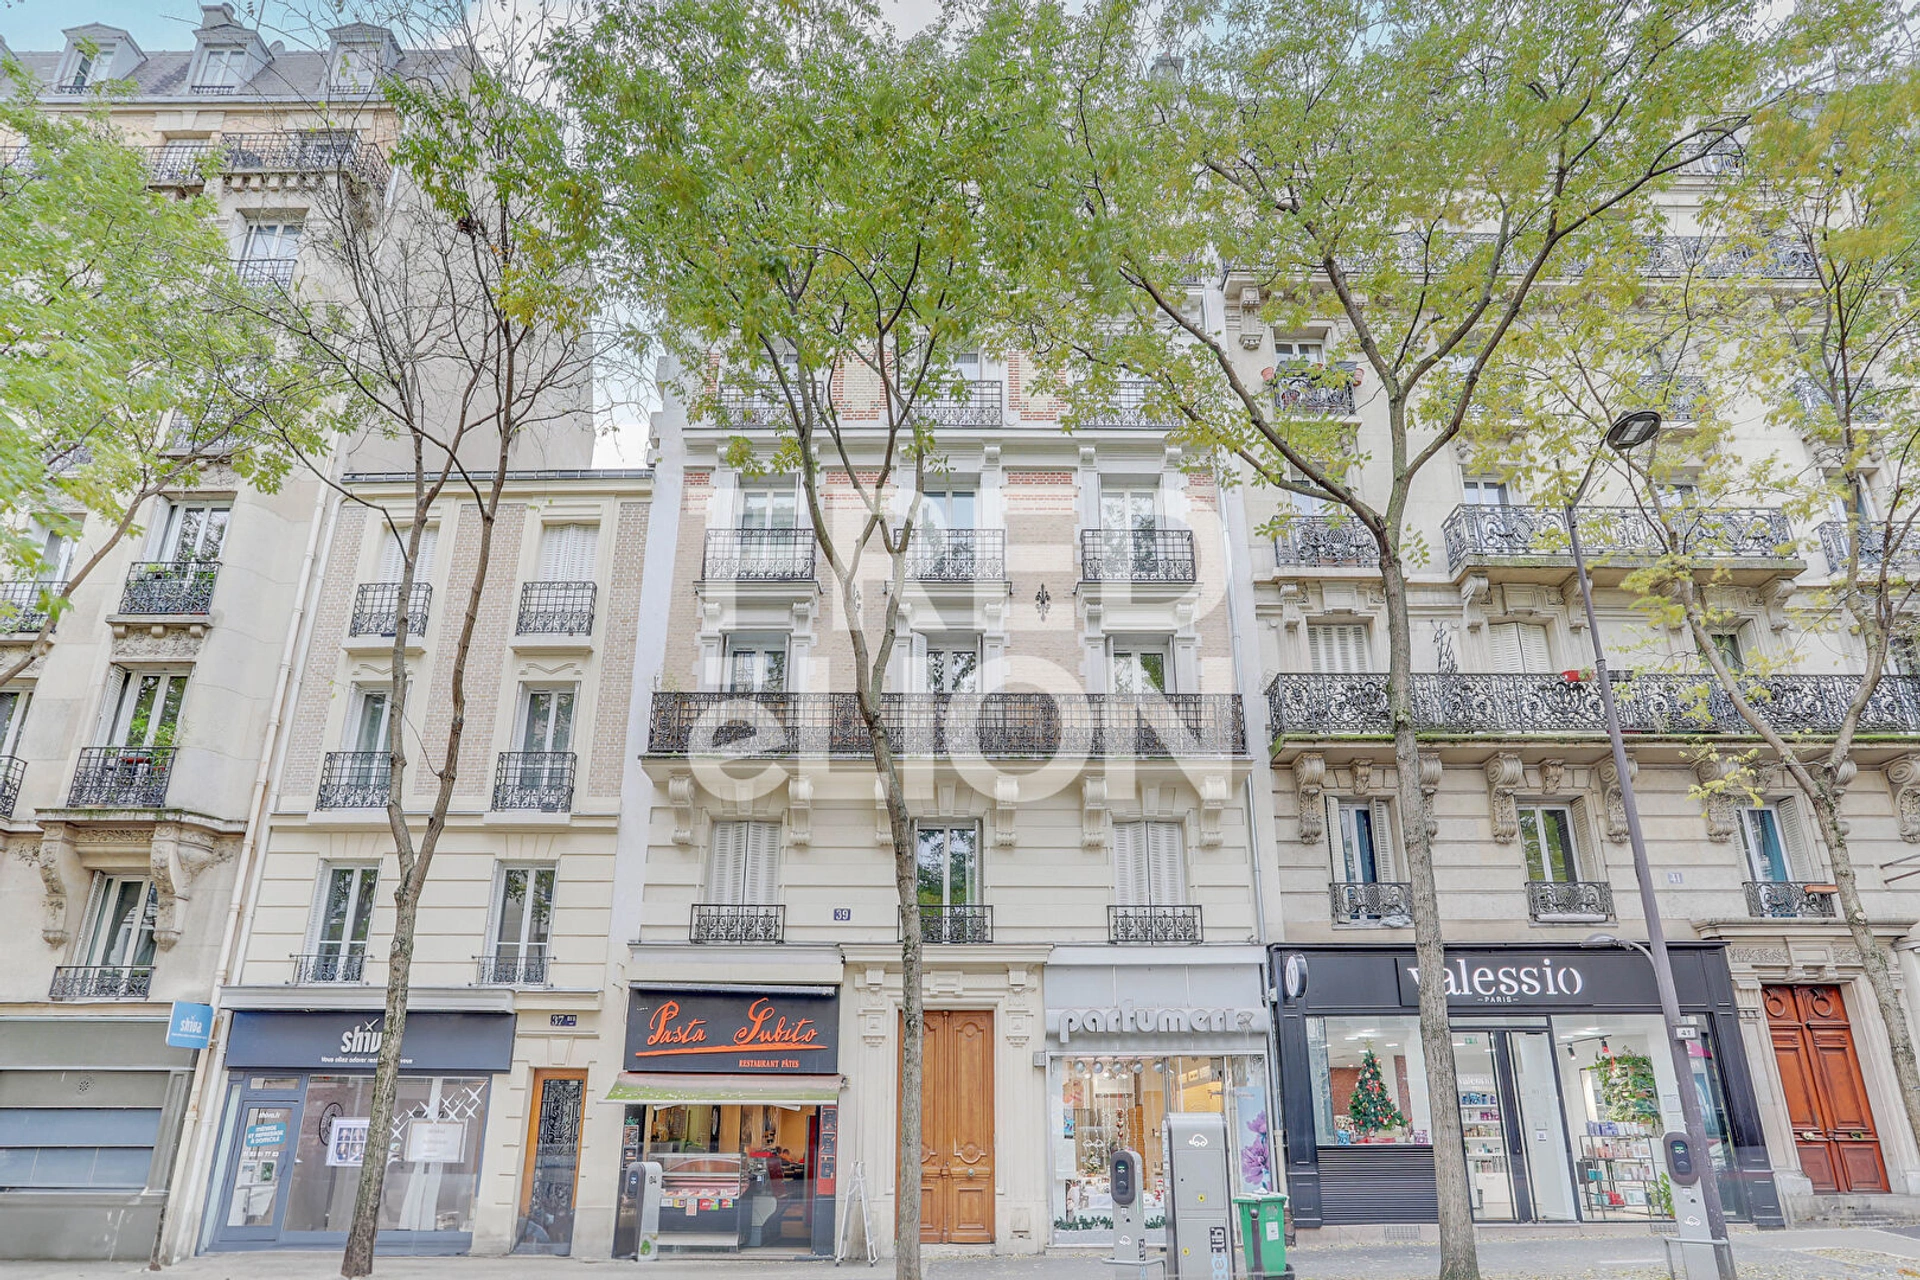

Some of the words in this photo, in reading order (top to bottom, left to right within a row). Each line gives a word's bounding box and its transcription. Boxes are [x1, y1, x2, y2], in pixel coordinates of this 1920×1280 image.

[835, 909, 849, 920] 39
[552, 1015, 565, 1026] 37
[647, 1001, 706, 1046] Pasta
[734, 998, 817, 1045] Subito
[1059, 999, 1254, 1044] parfumeri
[340, 1018, 383, 1054] shiv
[739, 1059, 779, 1068] RESTAURANT
